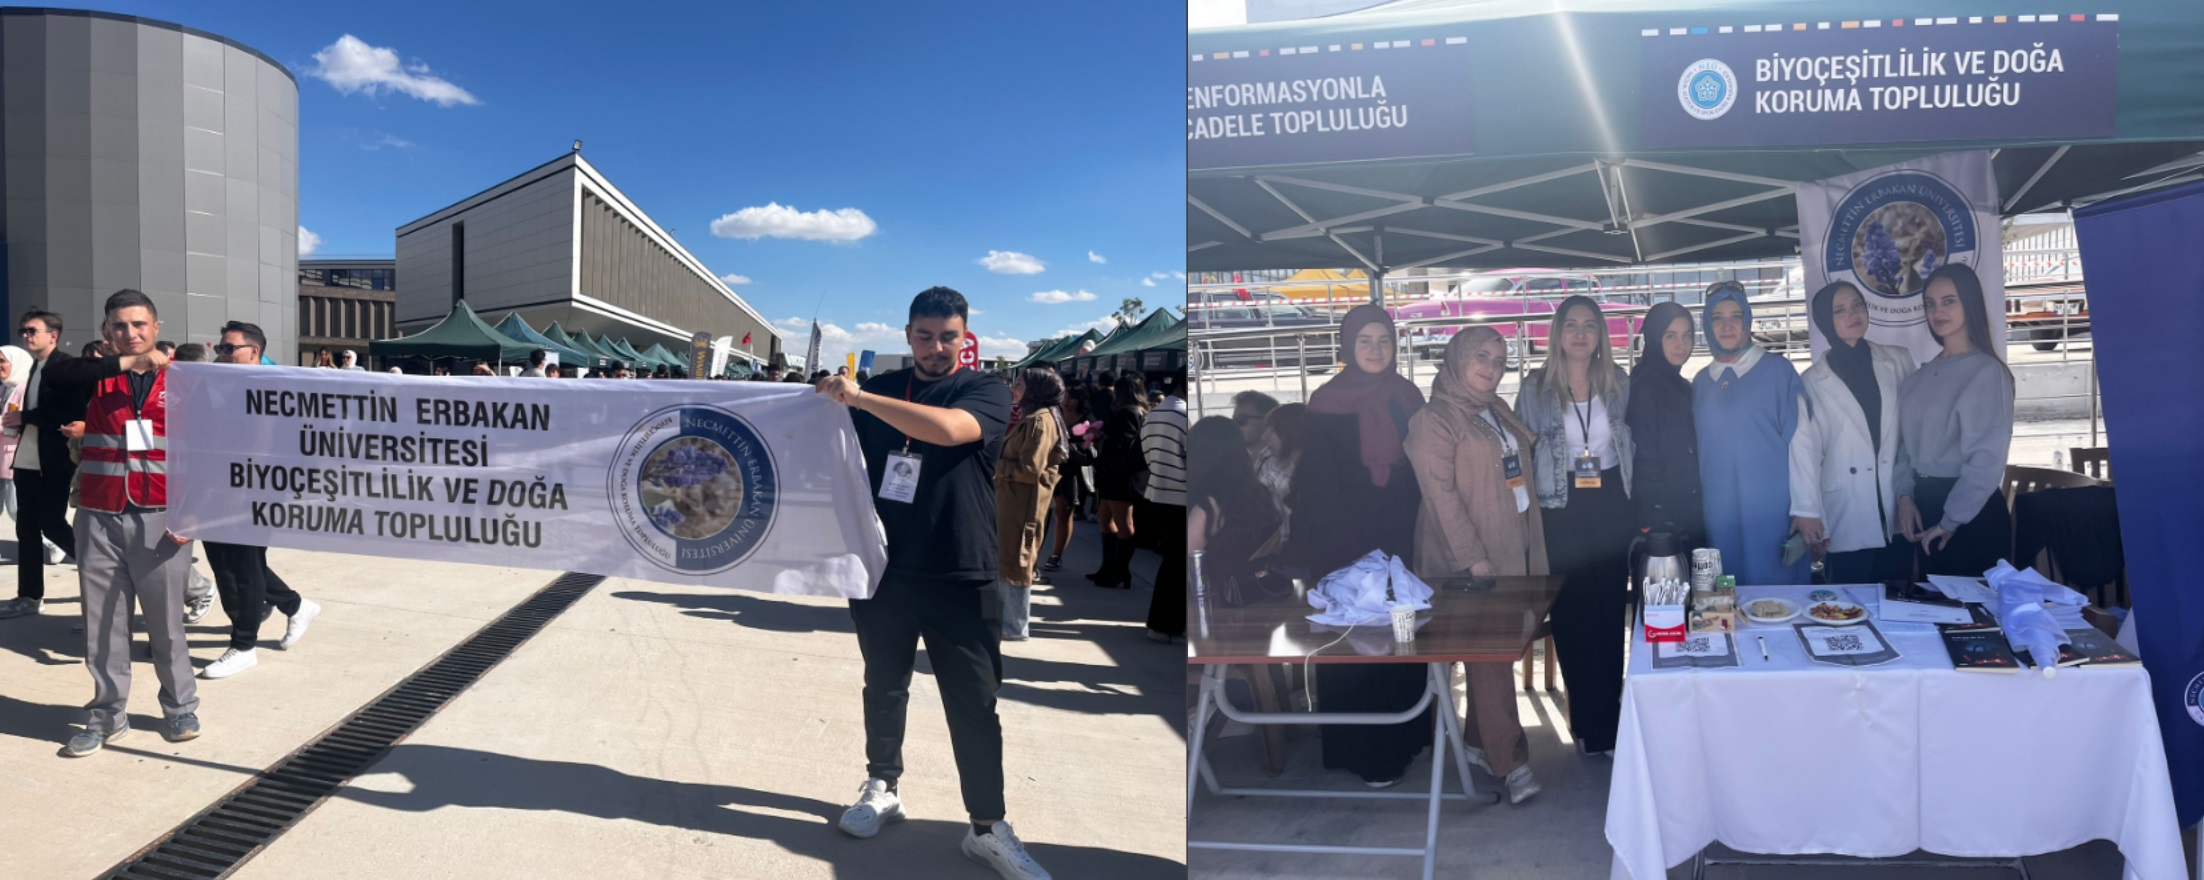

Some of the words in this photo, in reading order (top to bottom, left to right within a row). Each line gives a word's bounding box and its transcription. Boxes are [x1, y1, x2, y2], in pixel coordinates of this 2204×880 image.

[1756, 47, 1947, 86] BİYOÇEŞİTLİLİK
[1954, 50, 1985, 76] VE
[1993, 42, 2065, 74] DOĞA
[1269, 99, 1408, 135] TOPLULUĞU
[1755, 89, 1863, 114] KORUMA
[1869, 76, 2021, 111] TOPLULUĞU
[1864, 184, 1917, 205] ERBAKAN
[246, 389, 398, 423] NECMETTİN
[416, 397, 550, 431] ERBAKAN
[299, 423, 489, 467] ÜNİVERSİTESİ
[684, 416, 753, 457] NECMETTİN
[746, 458, 764, 518] ERBAKAN
[229, 457, 434, 502] BİYOÇEŞİTLİLİK
[443, 476, 479, 504] VE
[486, 475, 568, 510] DOĞA
[251, 500, 364, 535] KORUMA
[373, 509, 542, 548] TOPLULUĞU
